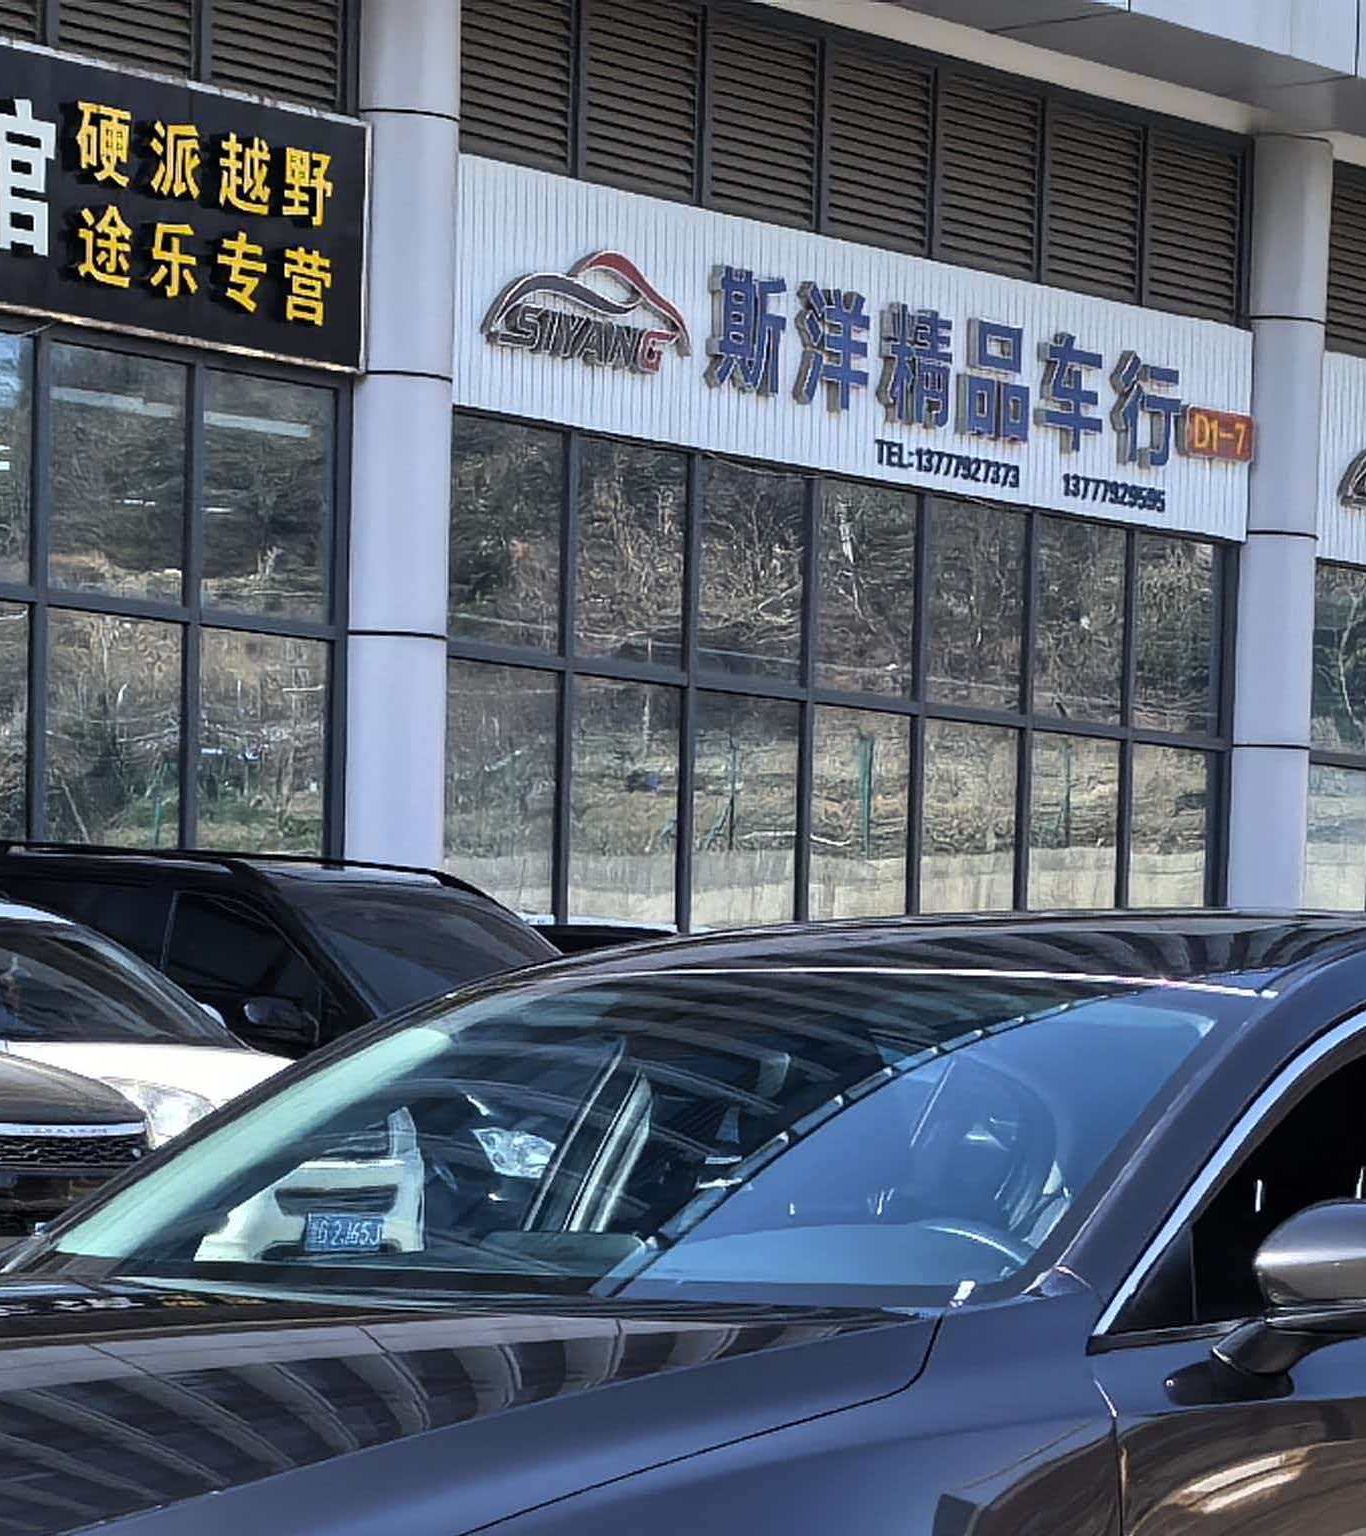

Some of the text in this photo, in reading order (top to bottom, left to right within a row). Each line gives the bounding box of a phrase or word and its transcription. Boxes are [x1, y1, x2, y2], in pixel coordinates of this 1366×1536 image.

[76, 101, 334, 226] 硬派越野
[78, 204, 332, 327] 途乐专营
[706, 265, 1184, 468] 斯洋精品车行
[1192, 422, 1246, 456] D1-7
